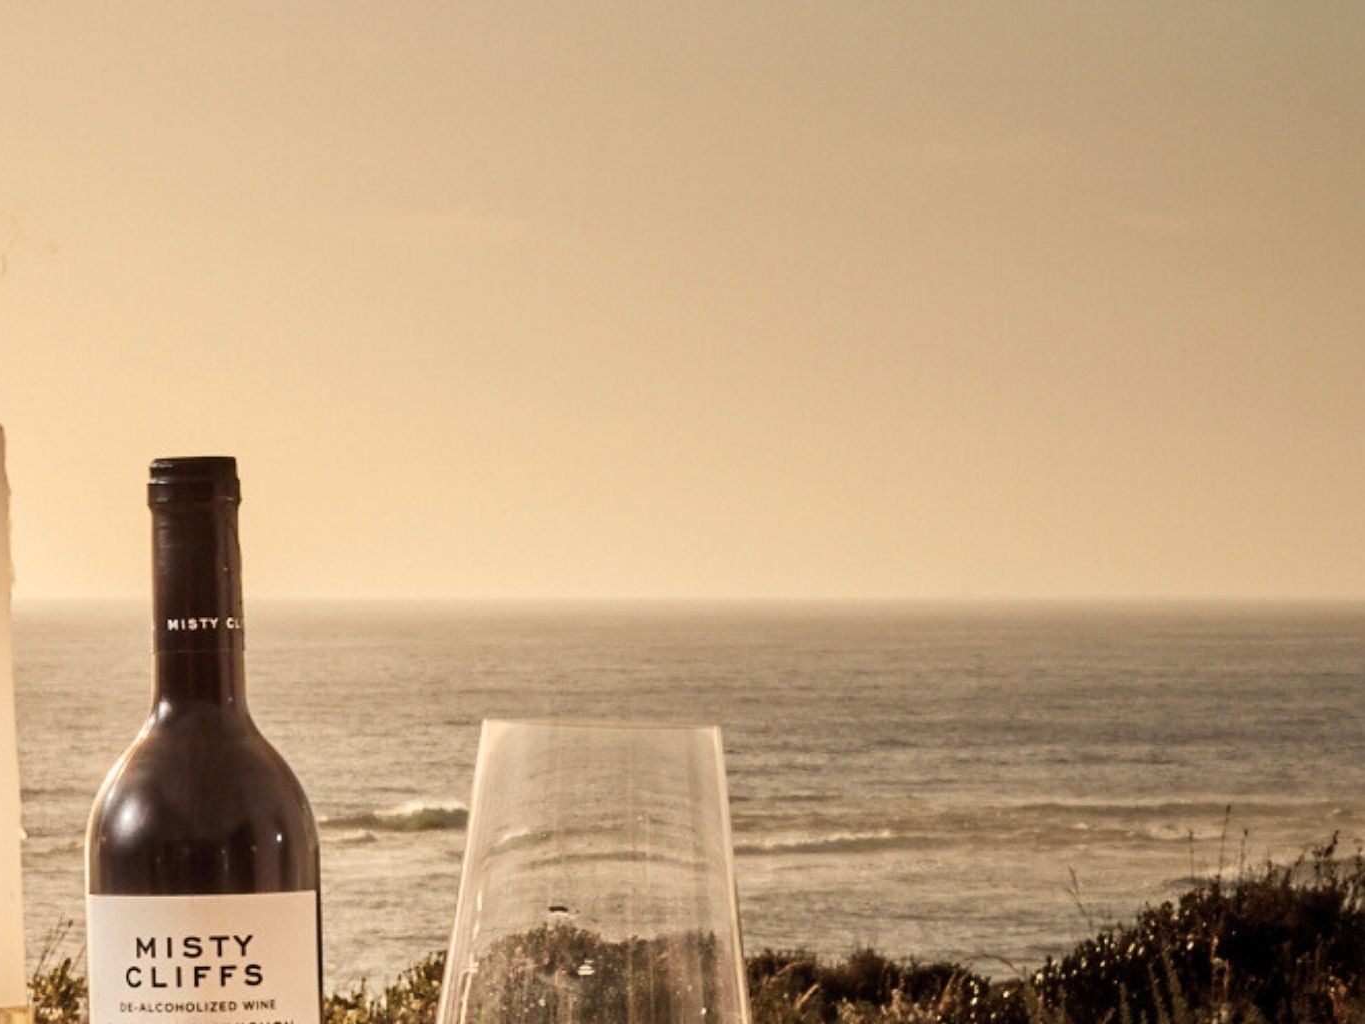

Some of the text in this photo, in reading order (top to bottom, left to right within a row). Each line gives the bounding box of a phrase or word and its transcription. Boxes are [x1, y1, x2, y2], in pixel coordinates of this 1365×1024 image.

[166, 617, 218, 631] MISTY
[135, 935, 254, 959] MISTY
[125, 964, 264, 988] CLIFFS
[119, 999, 277, 1013] DE-ALCOHOLIZED WINE
